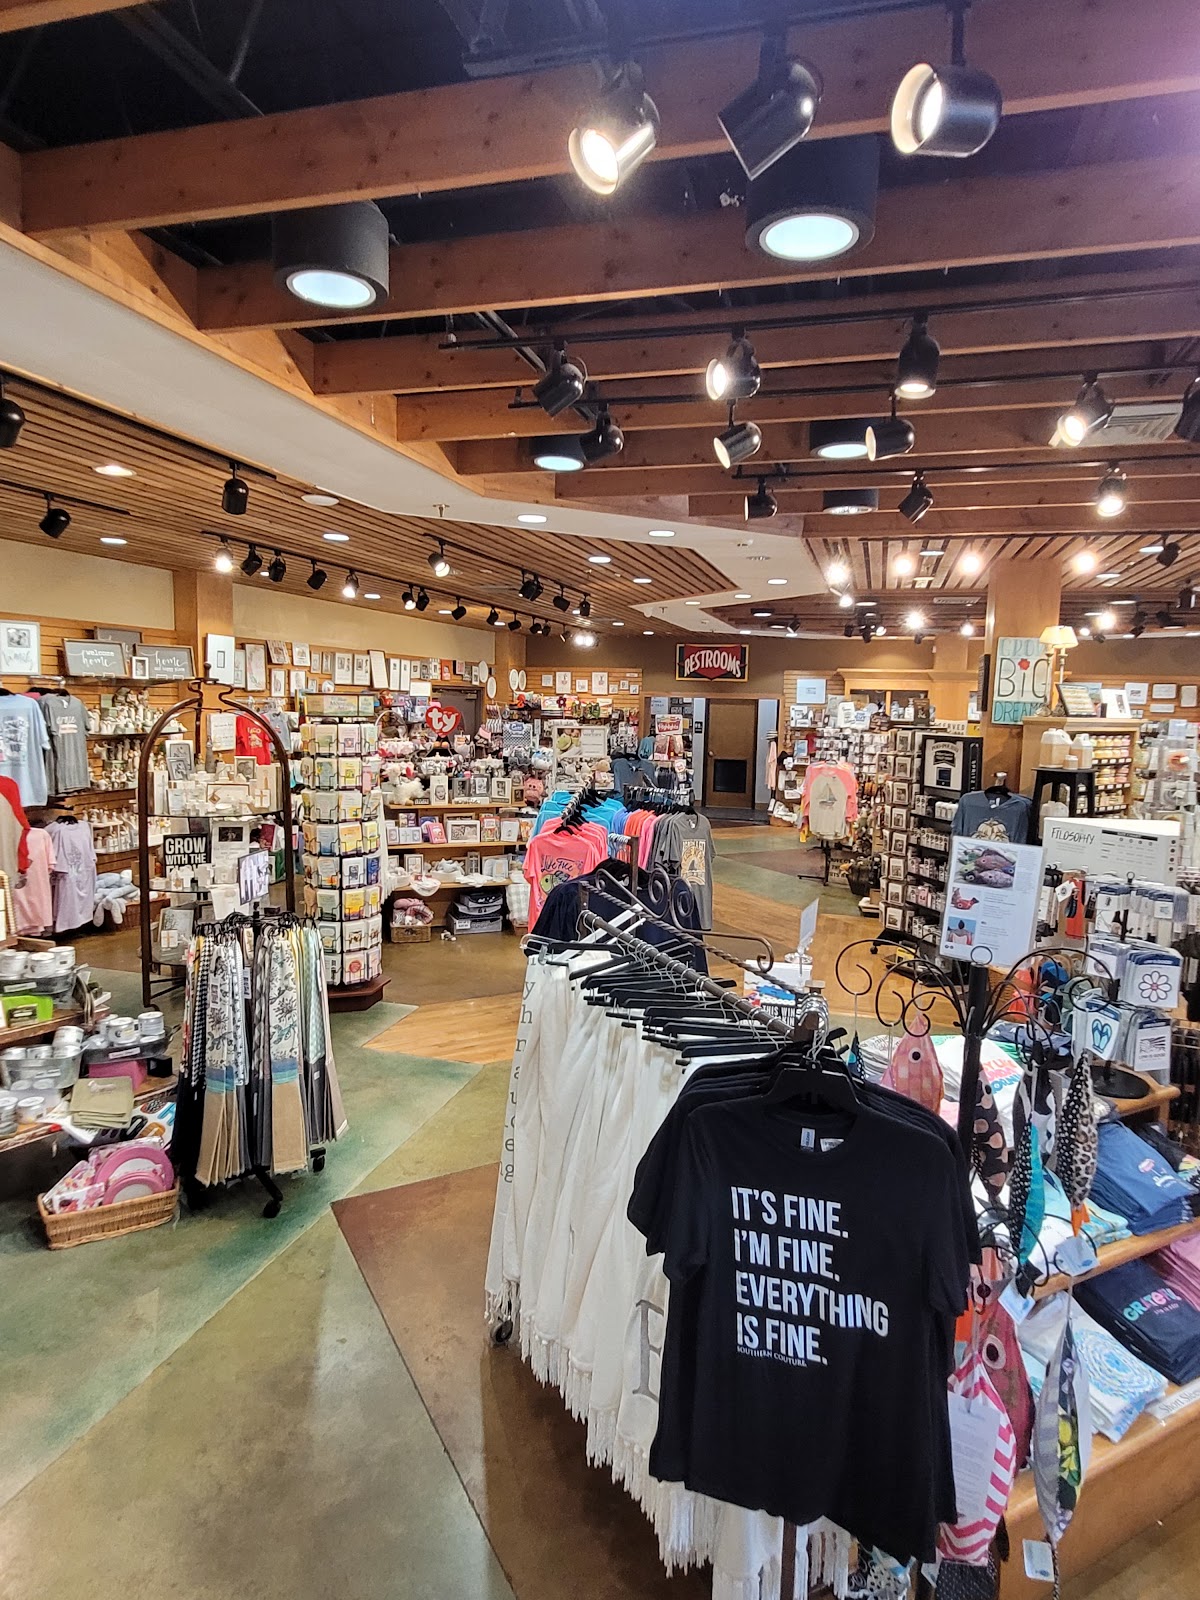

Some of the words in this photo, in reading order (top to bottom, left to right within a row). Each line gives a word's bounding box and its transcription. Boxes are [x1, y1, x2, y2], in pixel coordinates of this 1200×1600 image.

[82, 649, 117, 668] home
[155, 650, 188, 667] home
[684, 649, 742, 678] RESTROOMS
[428, 708, 459, 733] ty
[1051, 827, 1095, 845] FILOSOPHY
[165, 837, 206, 855] GROW
[165, 855, 188, 866] WITH
[189, 853, 206, 864] THE
[781, 1007, 796, 1017] WIN
[731, 1186, 777, 1225] IT'S
[783, 1193, 849, 1239] FINE.
[733, 1227, 771, 1268] I'M
[777, 1235, 840, 1282] FINE.
[735, 1269, 889, 1337] EVERYTHING
[736, 1312, 760, 1350] IS
[766, 1318, 828, 1366] FINE.
[737, 1346, 773, 1359] SOUTHERN
[1158, 1398, 1185, 1413] Short
